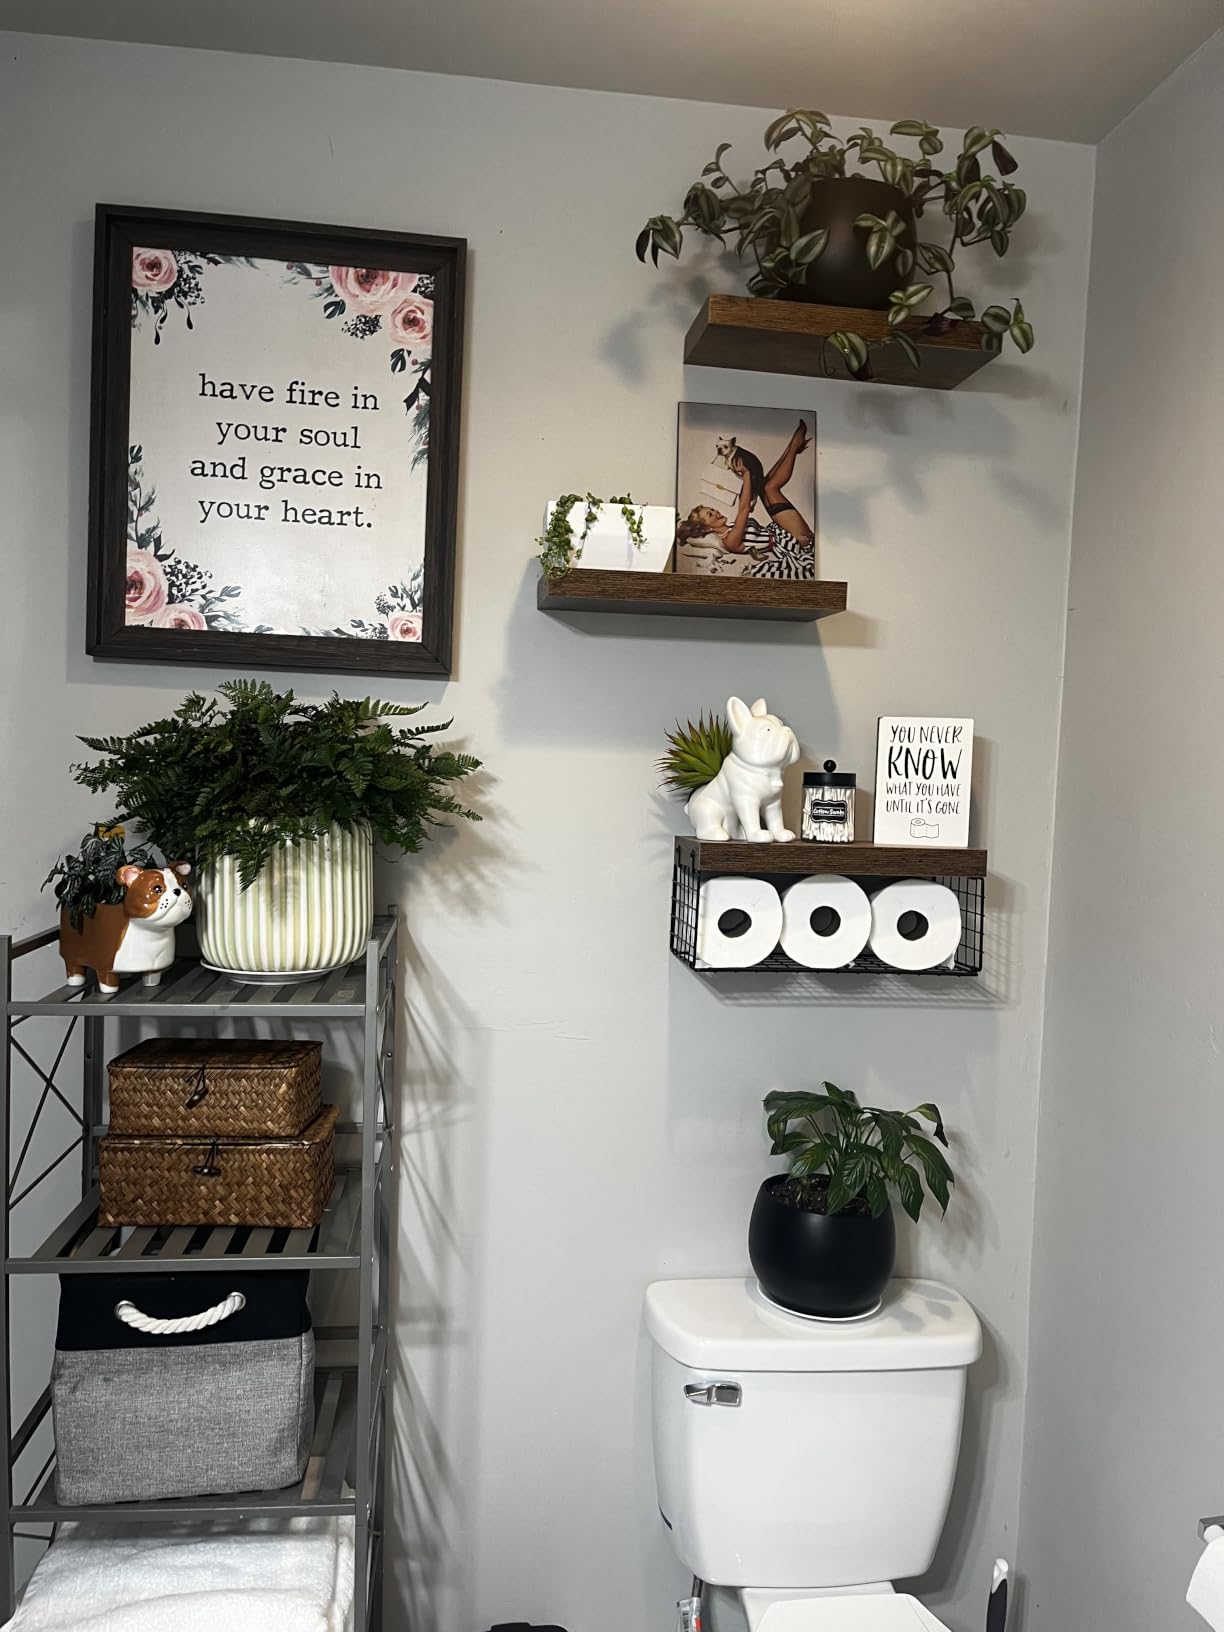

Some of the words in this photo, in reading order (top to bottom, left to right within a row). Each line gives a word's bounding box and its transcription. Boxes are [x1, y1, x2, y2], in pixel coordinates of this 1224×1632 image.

[198, 372, 275, 403] have
[285, 380, 341, 409] fire
[351, 385, 380, 411] in
[215, 421, 288, 446] your
[299, 426, 362, 449] soul
[190, 456, 248, 480] and
[259, 465, 344, 490] grace
[354, 465, 383, 490] in
[198, 500, 270, 524] your
[281, 499, 372, 528] heart.
[890, 725, 916, 744] YOU
[919, 725, 963, 744] NEVER
[887, 745, 963, 780] KNOW
[885, 781, 913, 796] WHAT
[915, 782, 934, 797] YOU
[936, 783, 962, 797] HAVE
[885, 800, 913, 814] UNTIL
[916, 797, 933, 815] IT'S
[935, 801, 961, 815] GONE
